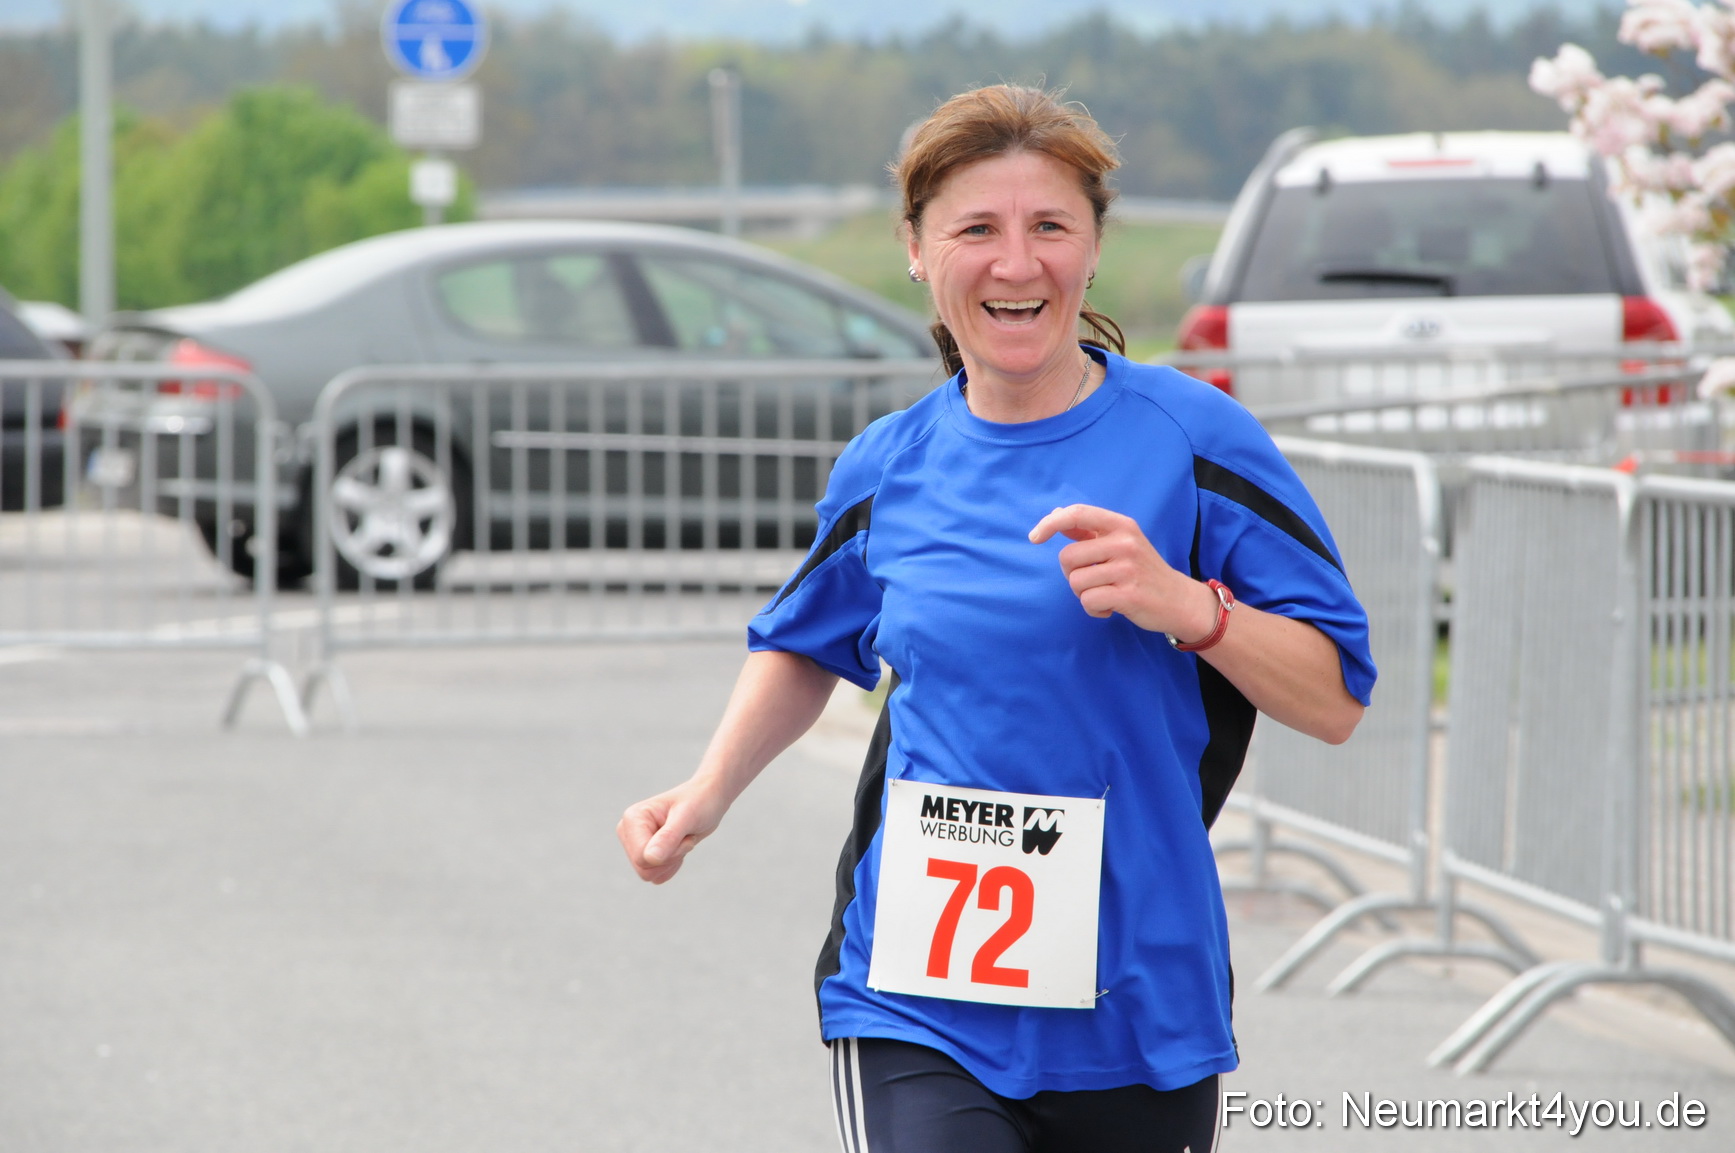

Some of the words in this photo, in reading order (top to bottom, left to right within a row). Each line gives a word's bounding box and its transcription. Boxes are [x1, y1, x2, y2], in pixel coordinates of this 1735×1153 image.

[920, 794, 1015, 828] MEYER
[920, 820, 1015, 847] WERBUNG
[926, 857, 1035, 989] 72
